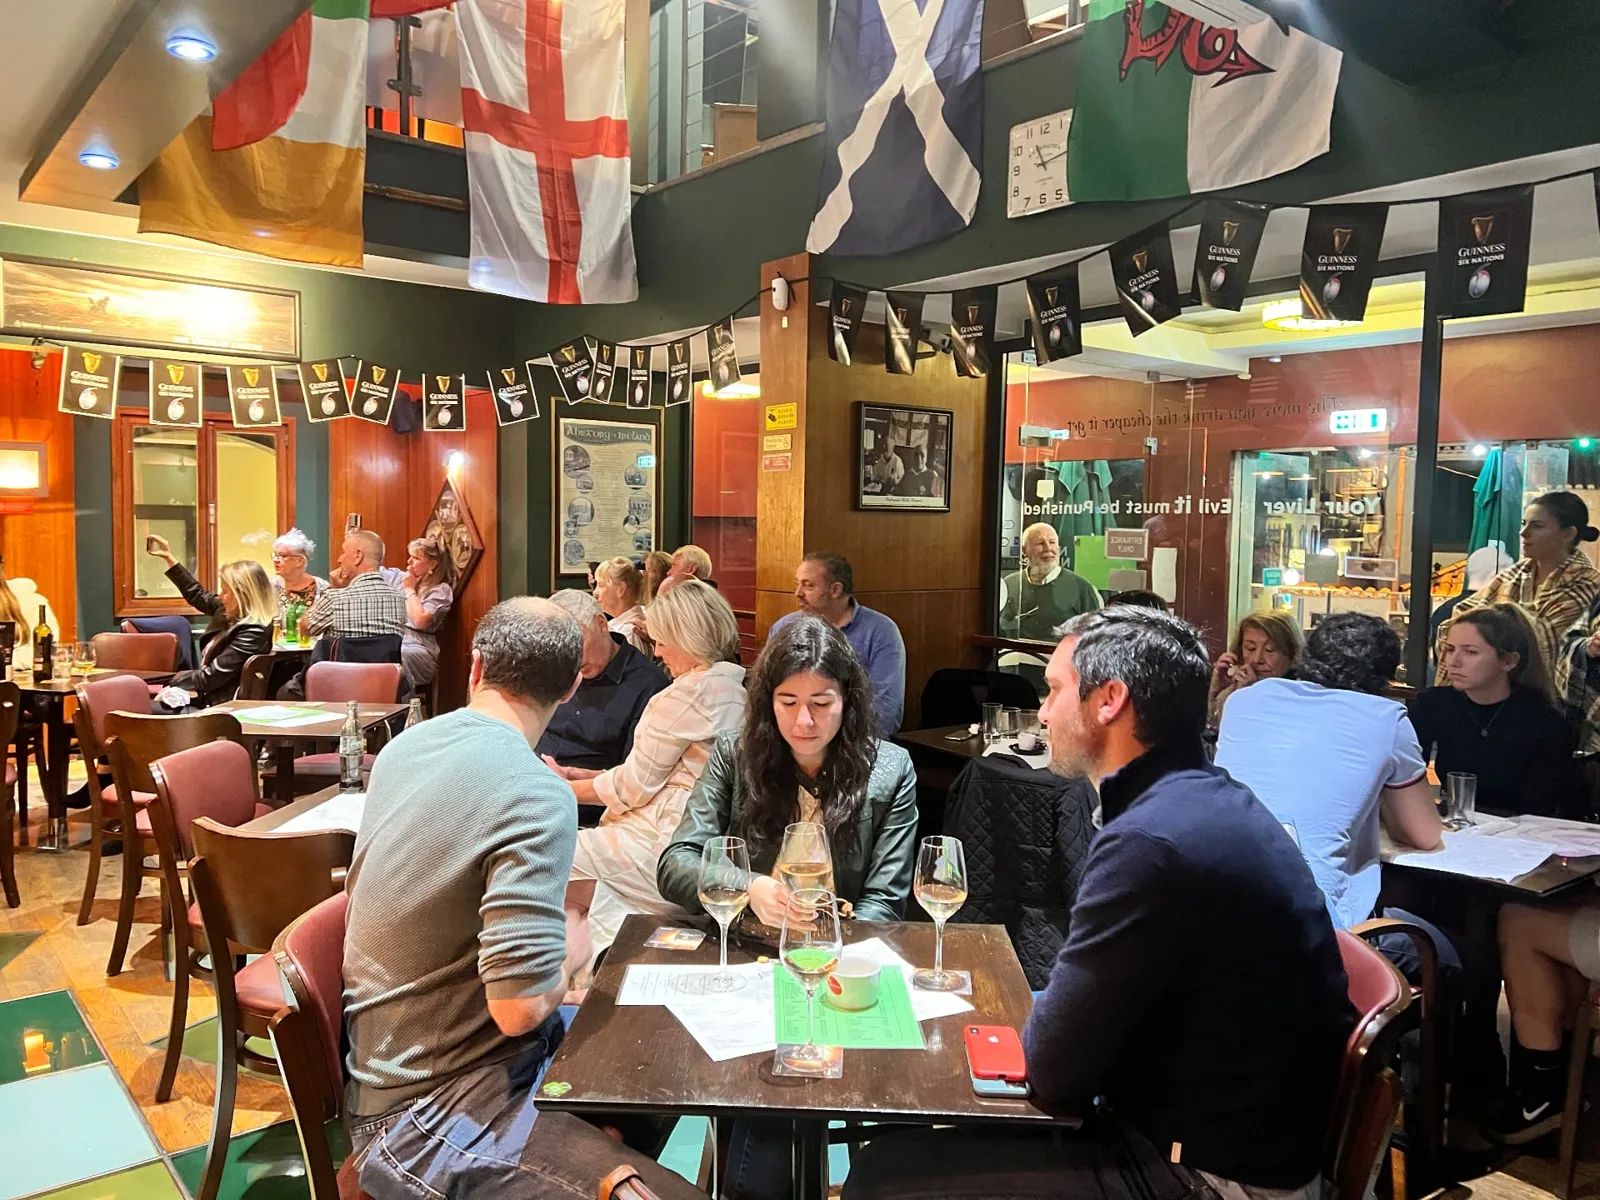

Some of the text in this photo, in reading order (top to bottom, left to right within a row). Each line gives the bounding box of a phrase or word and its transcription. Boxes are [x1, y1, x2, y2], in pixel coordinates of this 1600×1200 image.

[1026, 127, 1033, 140] 11
[1040, 122, 1050, 135] 12
[1014, 145, 1023, 158] 10
[1013, 165, 1020, 177] 9
[1013, 186, 1020, 198] 8
[1055, 188, 1063, 201] 5
[1024, 196, 1031, 208] 7
[1039, 193, 1047, 204] 6
[1209, 244, 1241, 256] GUINNESS
[1458, 243, 1506, 257] GUINNESS
[1216, 256, 1238, 264] NATIONS
[1318, 255, 1358, 264] GUINNESS
[1457, 253, 1505, 266] SIX NATIONS
[1128, 268, 1160, 287] GUINNESS
[1138, 276, 1161, 290] NATIONS
[1040, 305, 1068, 318] GUINNESS
[1048, 313, 1068, 323] NATIONS
[960, 324, 984, 334] GUINNESS
[561, 359, 589, 374] GUINNESS
[499, 383, 527, 395] GUINNESS
